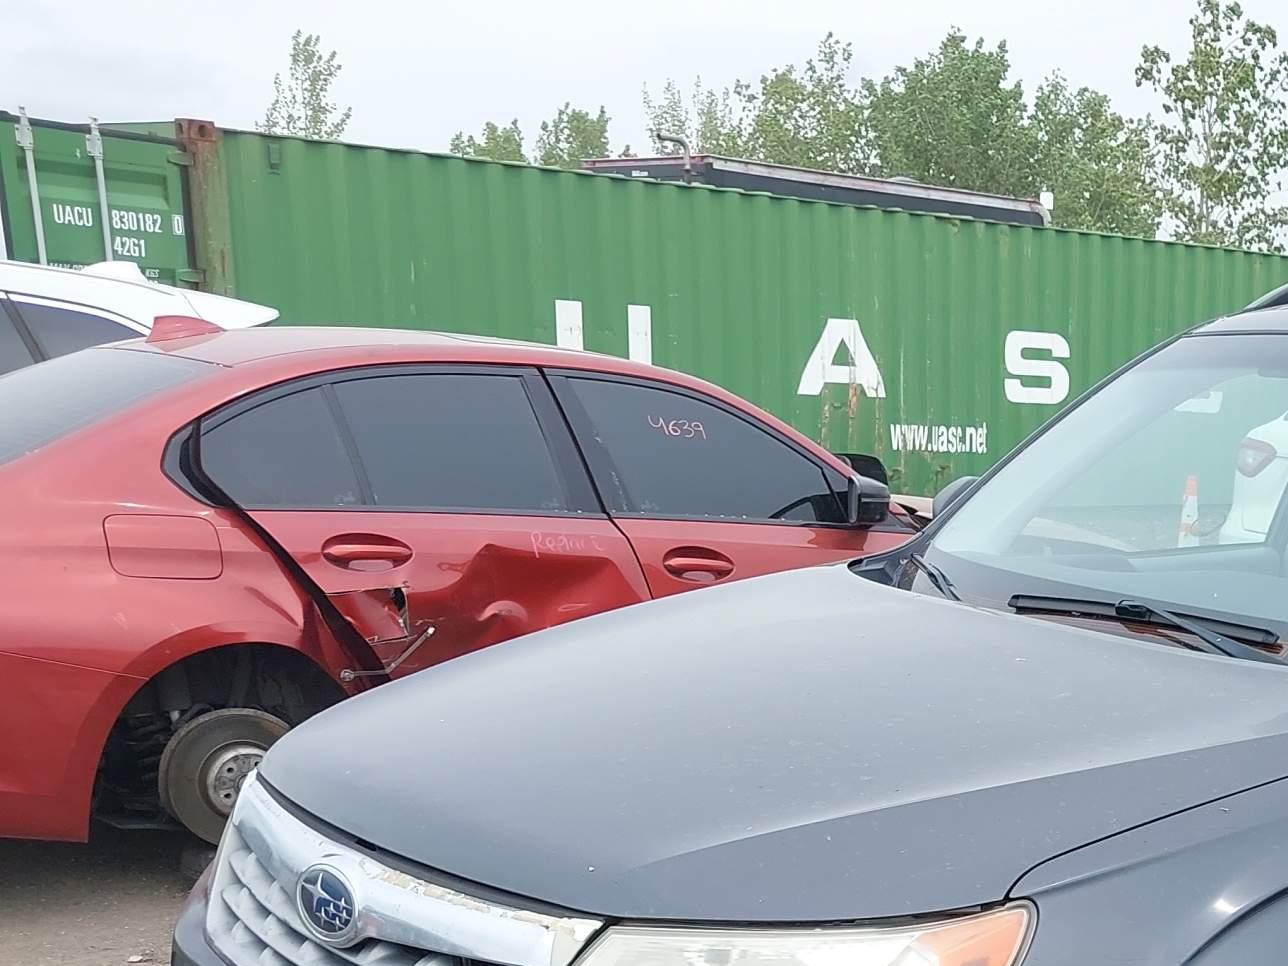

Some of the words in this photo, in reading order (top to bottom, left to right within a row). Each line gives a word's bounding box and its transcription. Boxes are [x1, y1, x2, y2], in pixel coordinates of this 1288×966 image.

[53, 203, 93, 227] UACU
[111, 209, 162, 233] 830182
[114, 236, 146, 258] 42G1
[648, 415, 706, 440] 4639
[890, 421, 987, 454] www.uasc.net
